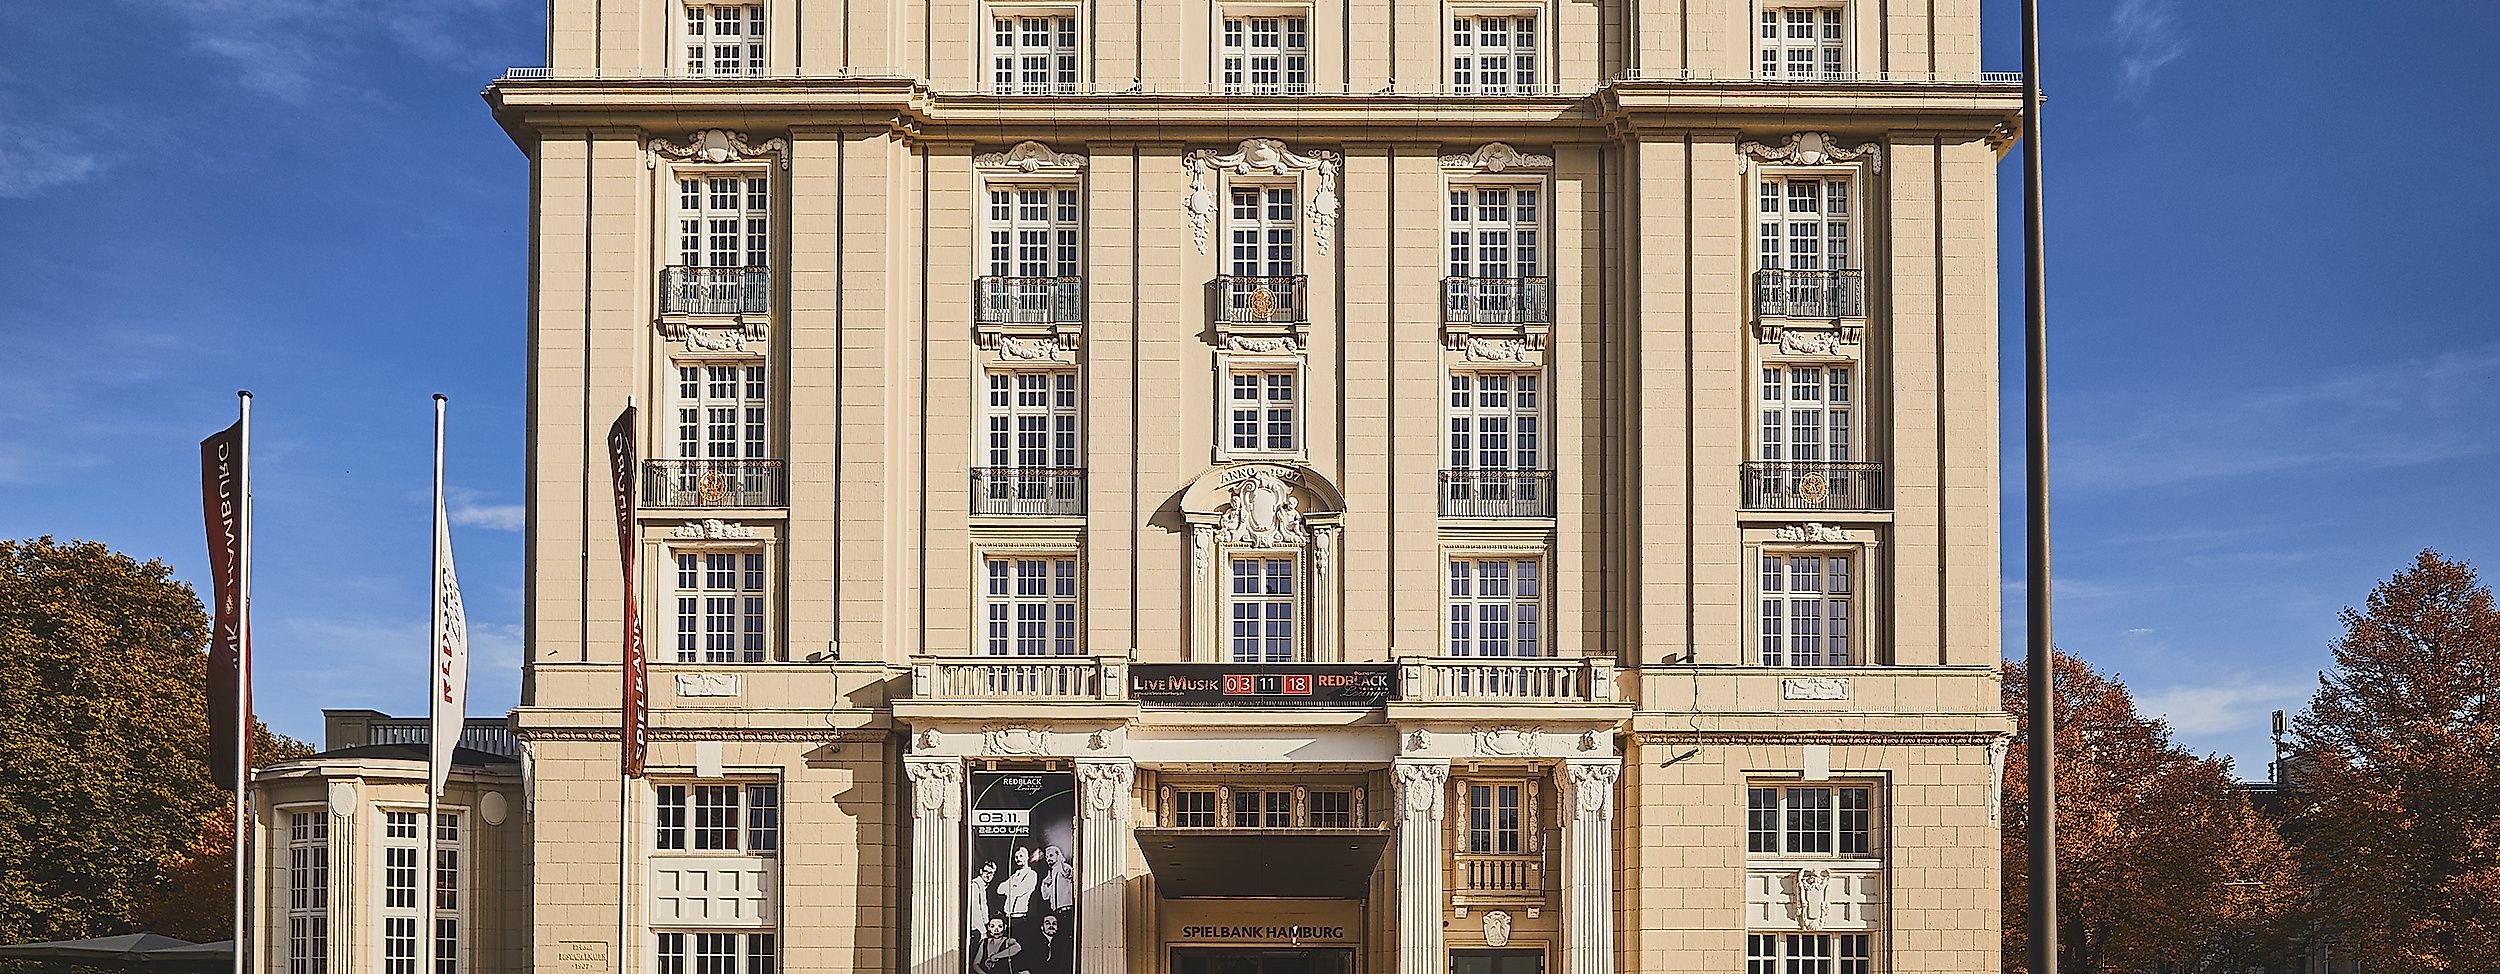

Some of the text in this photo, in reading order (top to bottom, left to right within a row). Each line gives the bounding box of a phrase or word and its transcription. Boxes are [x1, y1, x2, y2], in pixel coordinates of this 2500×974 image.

[1220, 467, 1301, 483] ANNO 1907
[1227, 678, 1306, 691] 03 11 18
[1318, 675, 1388, 686] REDBLACK
[979, 813, 1020, 823] 03.11.
[1183, 926, 1344, 938] SPIELBANK HAMBURG
